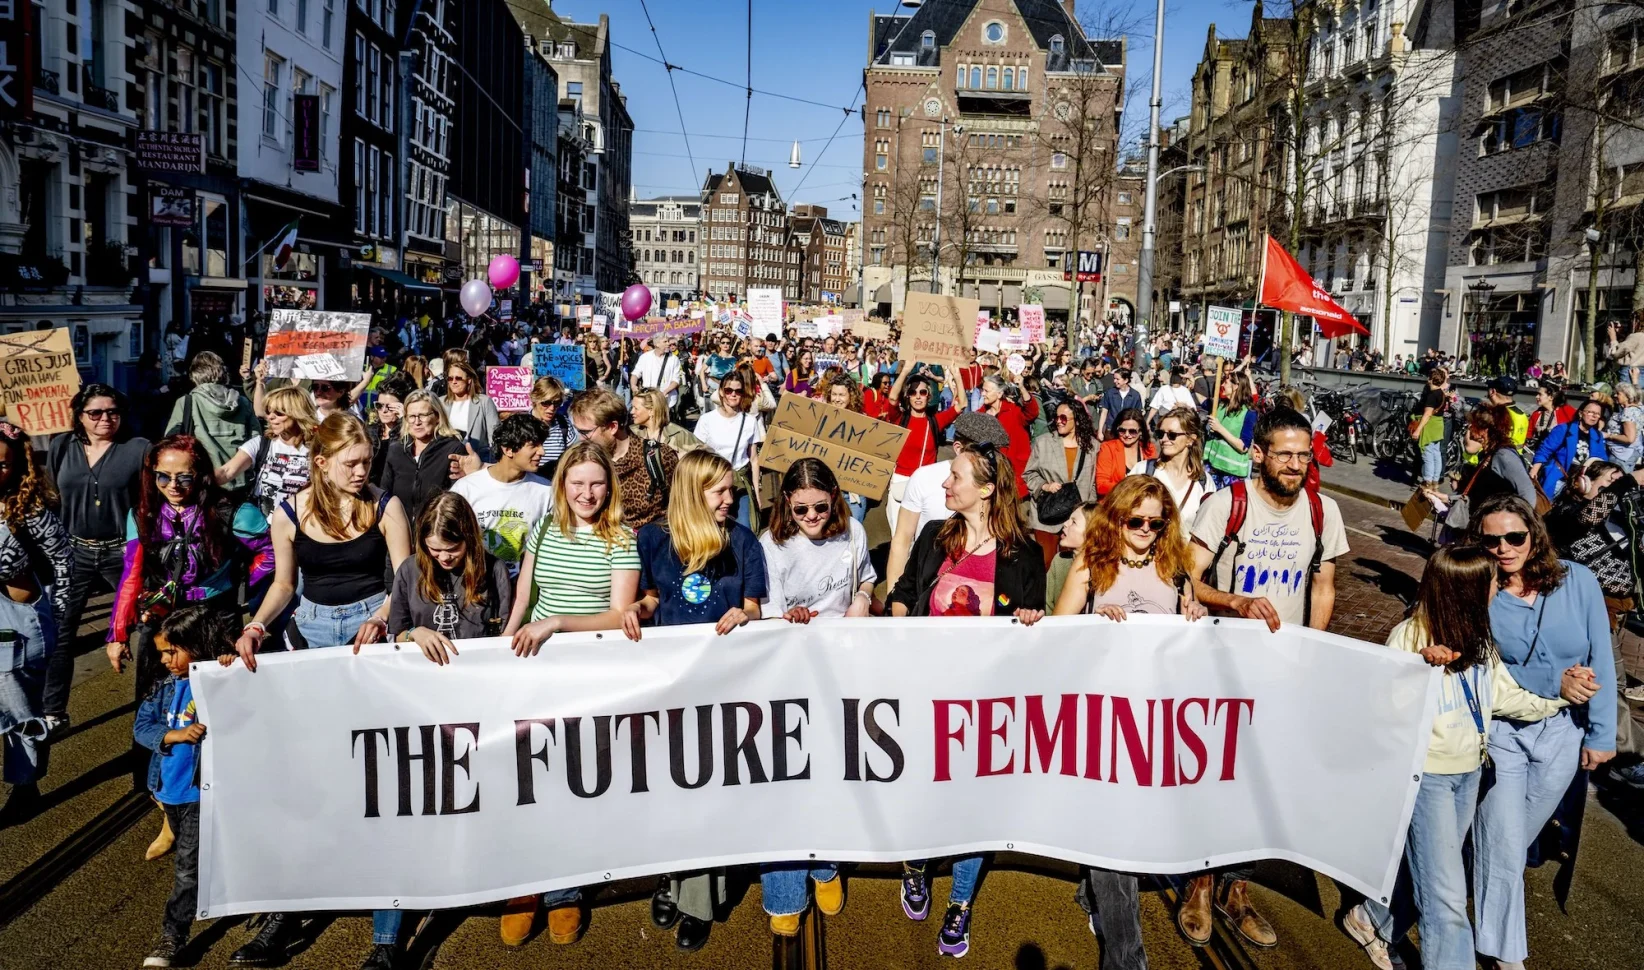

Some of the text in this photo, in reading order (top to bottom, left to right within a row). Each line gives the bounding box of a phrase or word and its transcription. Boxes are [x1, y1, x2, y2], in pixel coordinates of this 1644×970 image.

[137, 143, 172, 152] AUTHENTIC
[142, 152, 197, 162] RESTAURANT
[138, 160, 200, 172] MANDARIJN
[161, 188, 184, 196] DAM
[1312, 289, 1330, 302] the
[919, 302, 960, 321] VOOR
[1210, 309, 1242, 325] JOIN THE
[1300, 306, 1342, 319] actionaid
[663, 322, 673, 331] YA
[674, 318, 701, 329] BASTA!
[1209, 336, 1234, 345] FEMINIST
[535, 345, 579, 353] WE ARE
[5, 352, 72, 375] GIRLS JUST
[0, 371, 62, 390] WANNA HAVE
[817, 414, 868, 444] I AM
[837, 452, 875, 475] HER
[485, 510, 524, 518] FUTURE
[351, 693, 1255, 818] THE FUTURE IS FEMINIST
